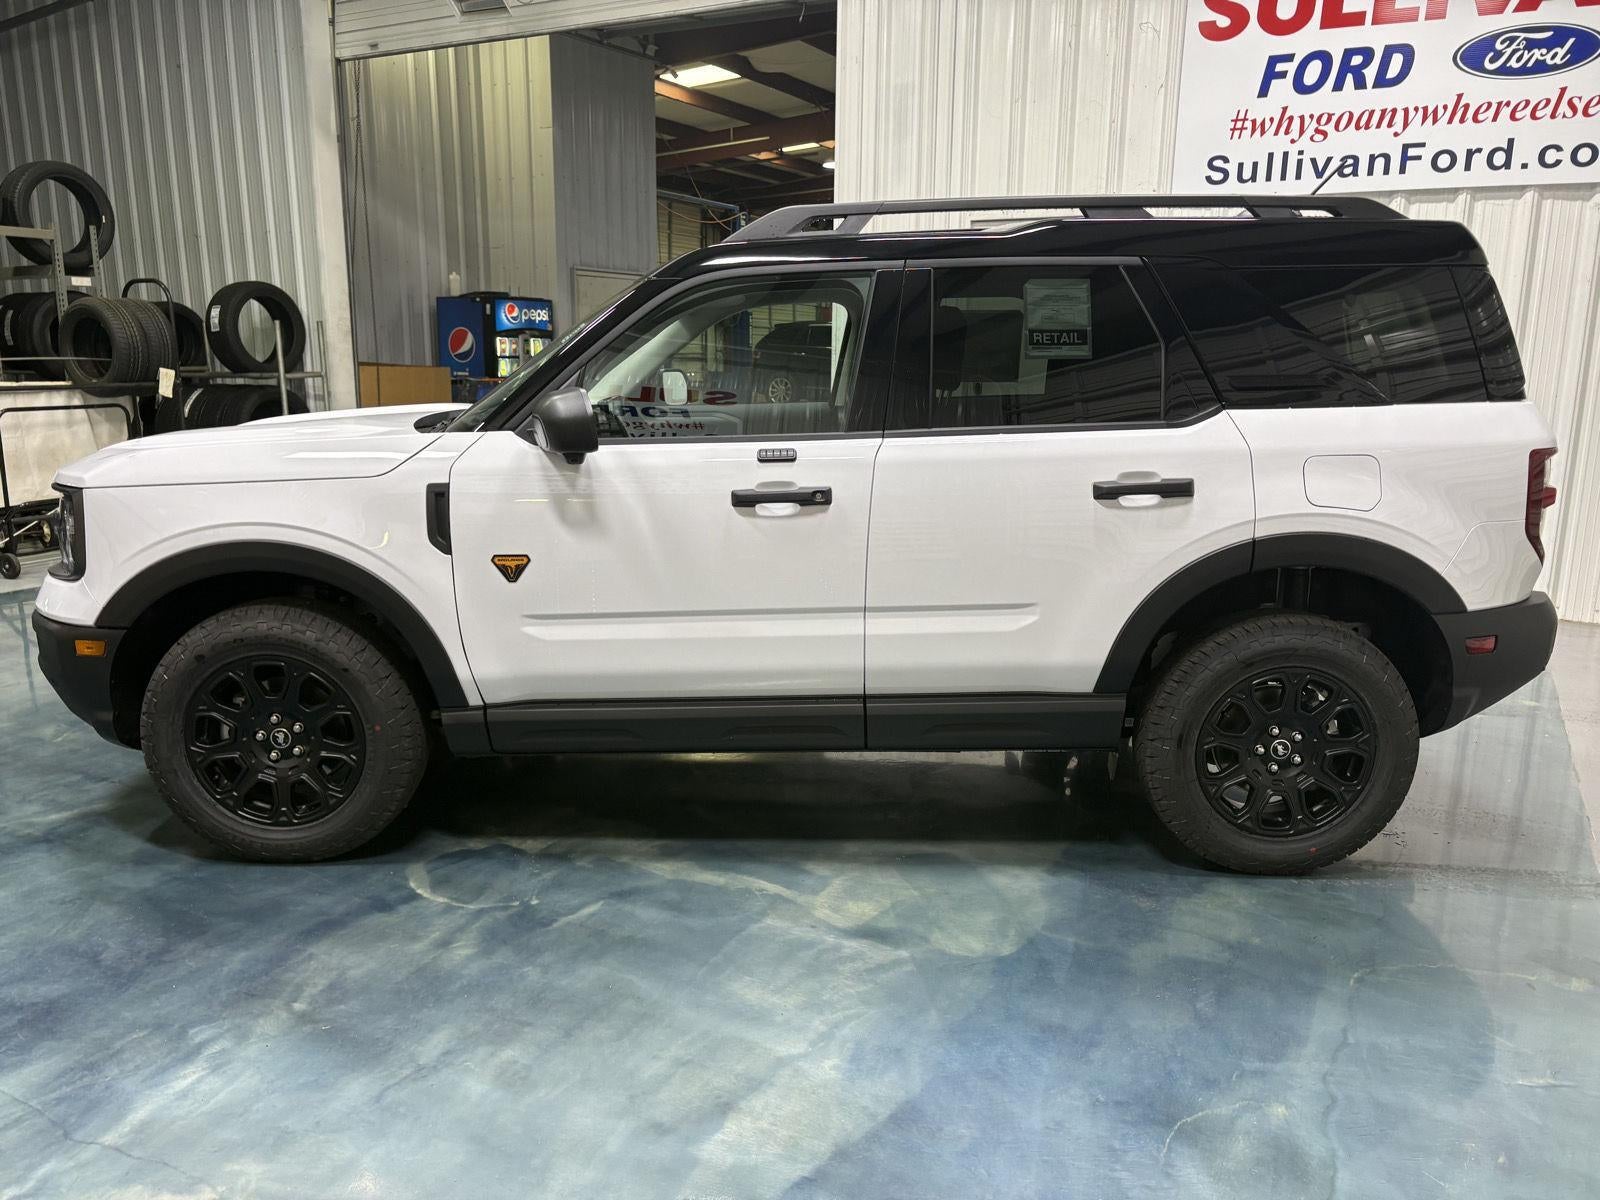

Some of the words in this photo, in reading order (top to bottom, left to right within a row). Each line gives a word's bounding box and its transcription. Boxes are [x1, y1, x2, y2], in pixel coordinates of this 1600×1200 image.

[1198, 0, 1600, 42] SULL
[1256, 43, 1416, 98] FORD
[1484, 31, 1576, 70] Ford
[1229, 86, 1600, 144] #whygoanywhereelse
[522, 308, 549, 323] pepsi
[1033, 332, 1082, 344] RETAIL
